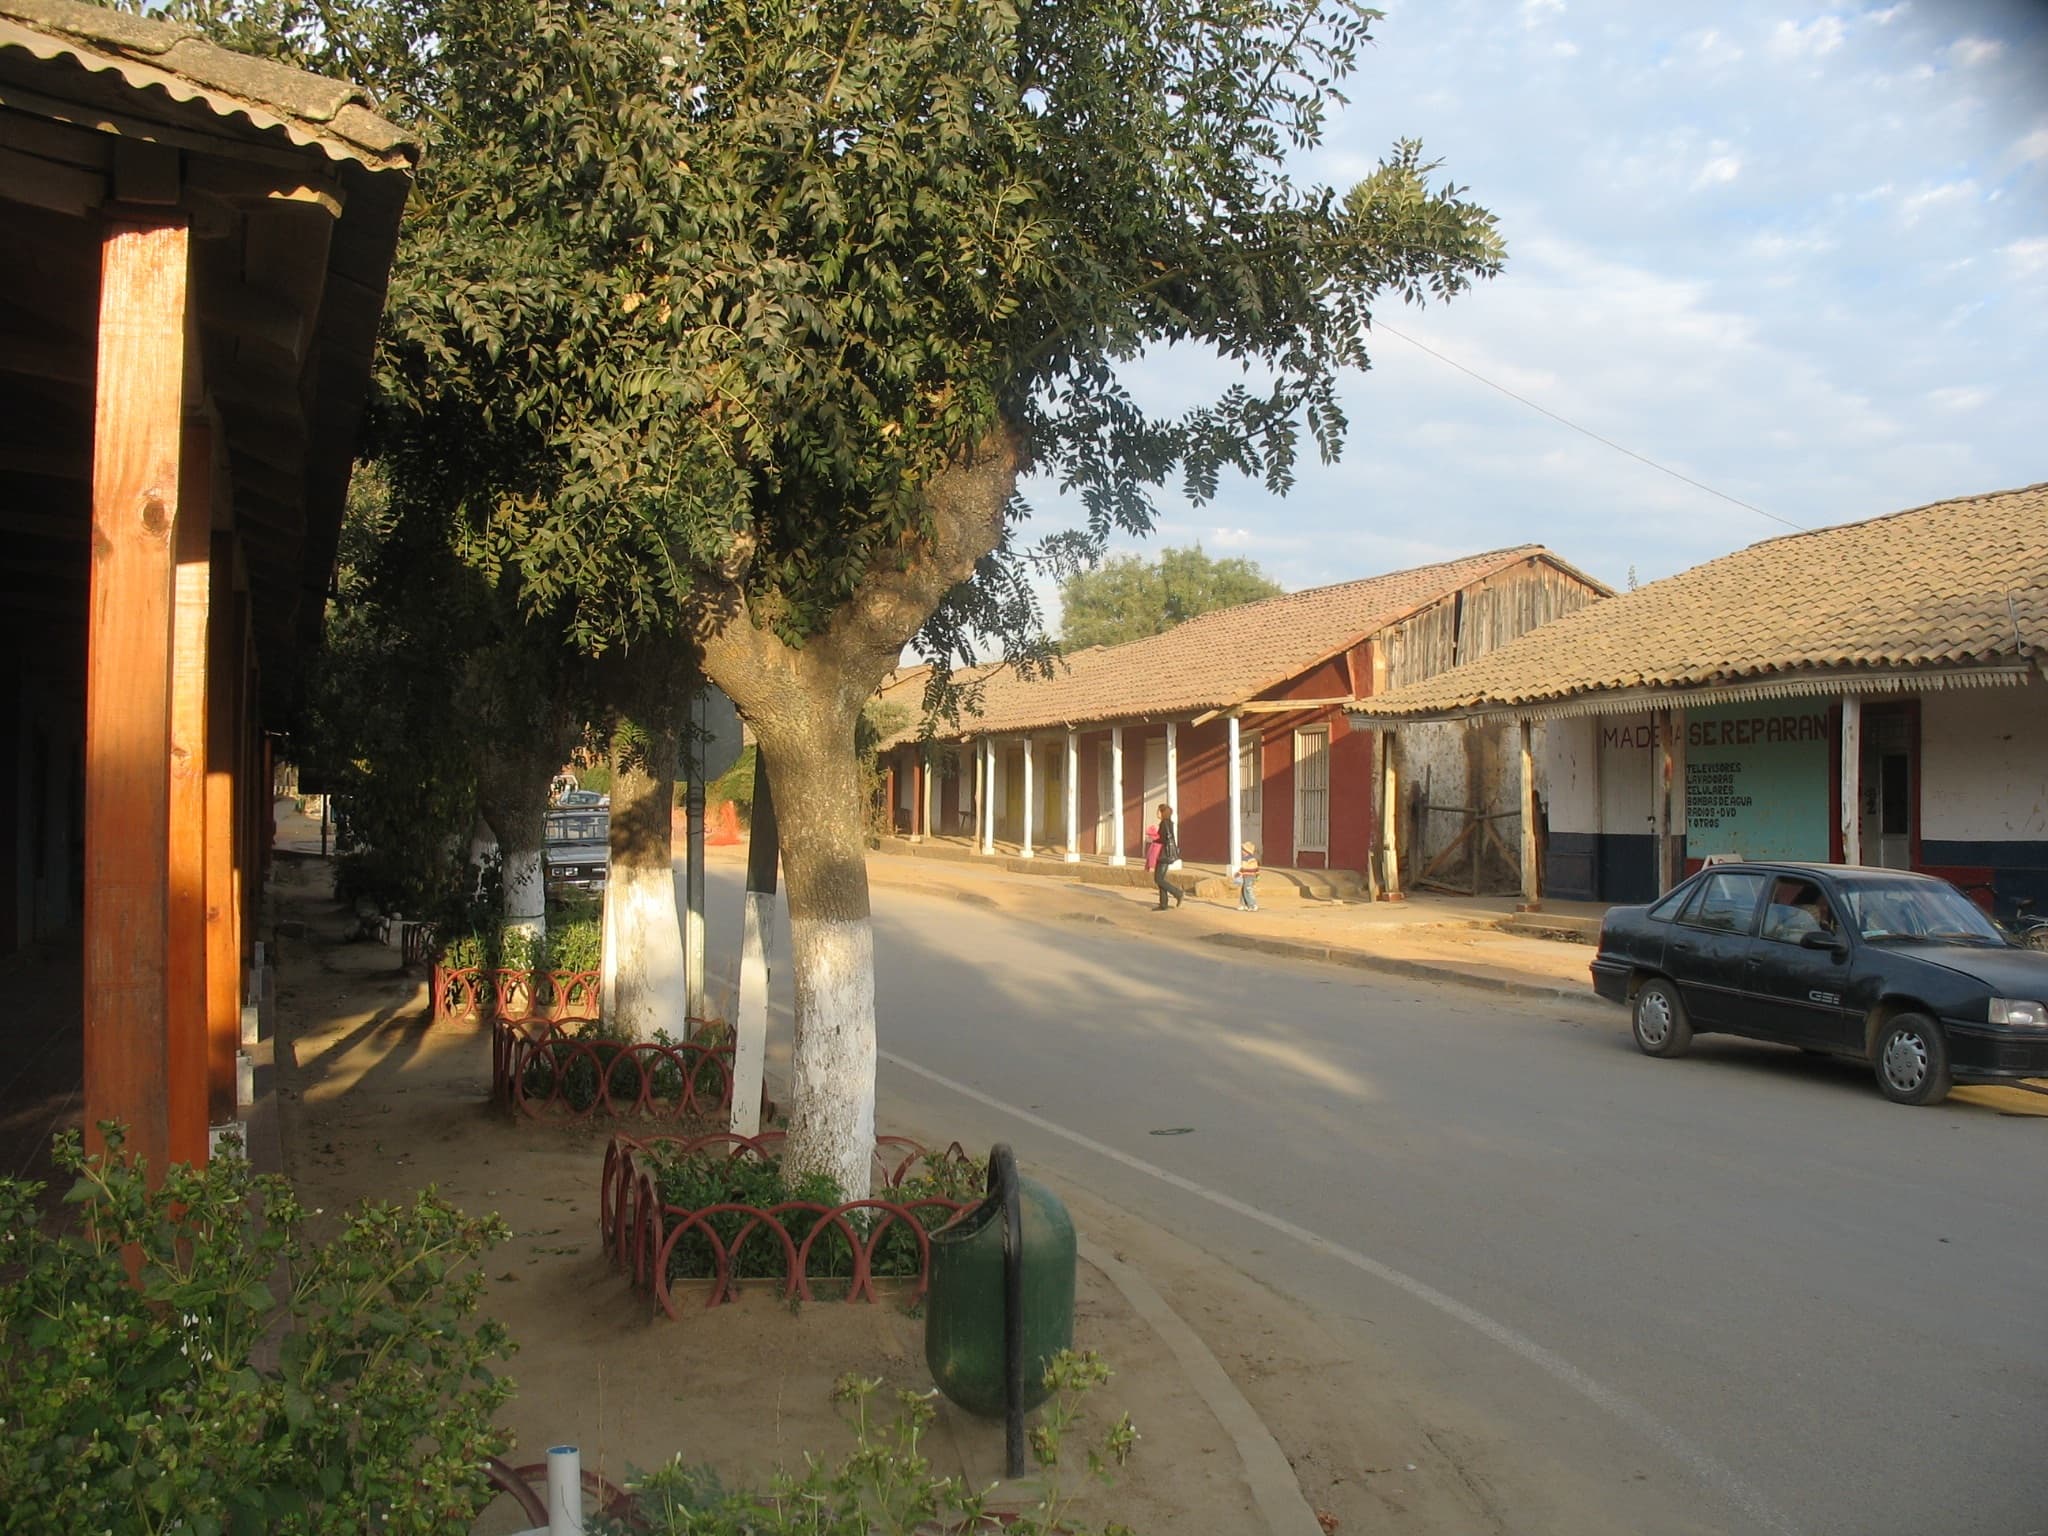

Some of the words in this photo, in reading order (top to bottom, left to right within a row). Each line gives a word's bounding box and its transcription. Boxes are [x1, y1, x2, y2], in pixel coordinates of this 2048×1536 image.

[1688, 721, 1717, 746] SE
[1721, 713, 1829, 745] REPARAN
[1687, 762, 1742, 773] TELEVISORES
[1687, 774, 1734, 784] LAVADORAS
[1687, 785, 1734, 795] CELULARES
[1687, 796, 1717, 806] BOMBAS
[1718, 796, 1729, 806] DE
[1730, 796, 1752, 806] AGUA
[1693, 818, 1720, 828] OTROS
